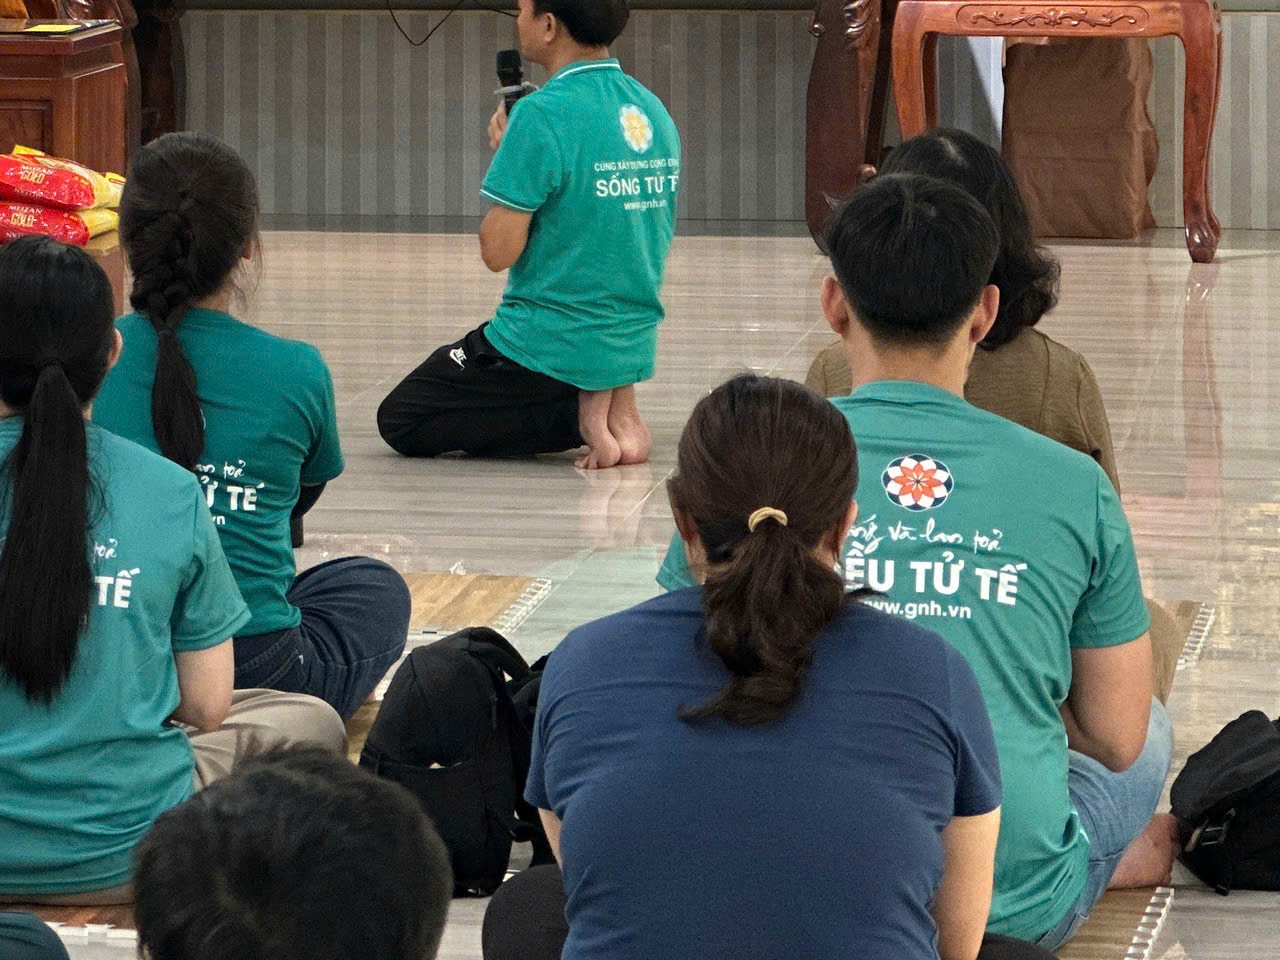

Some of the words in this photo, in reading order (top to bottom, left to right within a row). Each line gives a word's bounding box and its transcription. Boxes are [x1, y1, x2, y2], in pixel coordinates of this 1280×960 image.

[20, 170, 45, 184] GOLD
[596, 172, 640, 197] SỐNG
[8, 205, 43, 214] MEIZAN
[10, 213, 35, 227] GOLD
[919, 517, 964, 543] lan
[844, 541, 895, 592] ỀU
[910, 551, 965, 595] TỬ
[975, 563, 1028, 606] TẾ
[94, 567, 141, 608] TẾ
[863, 600, 972, 619] ww.gnh.vn
